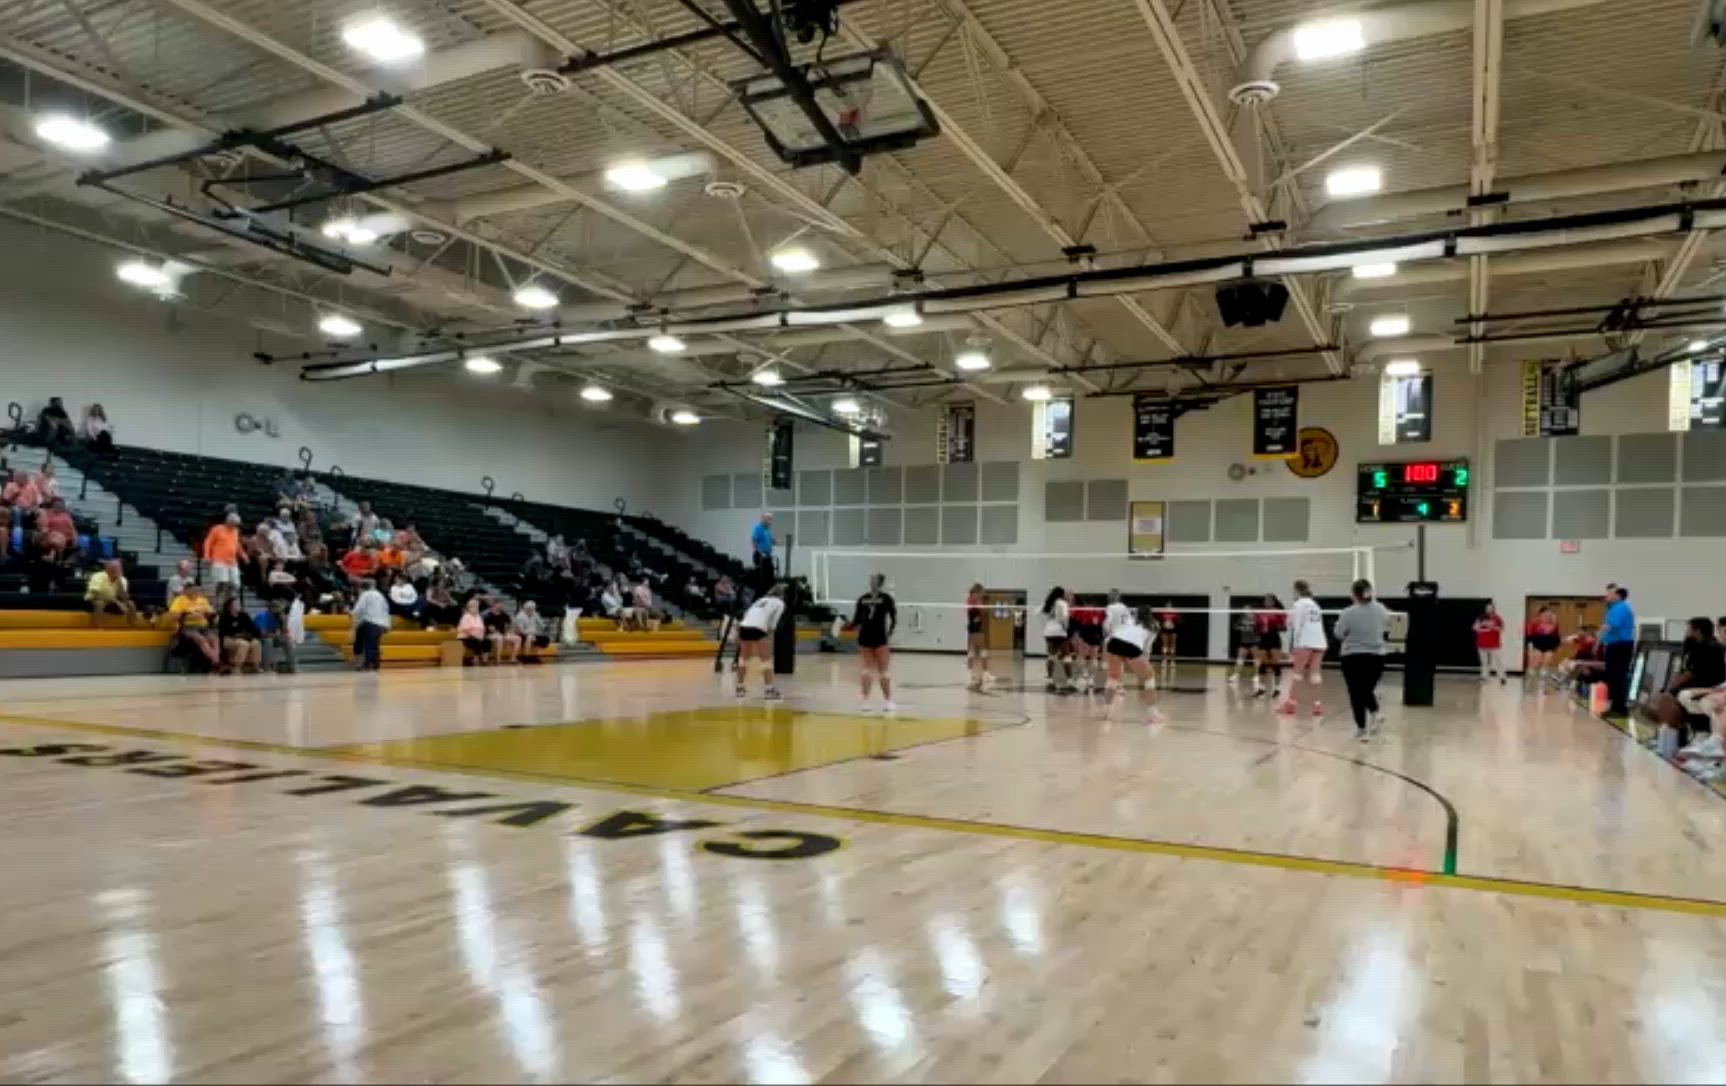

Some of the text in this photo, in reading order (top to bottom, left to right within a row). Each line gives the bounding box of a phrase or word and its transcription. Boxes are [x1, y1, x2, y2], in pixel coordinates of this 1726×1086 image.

[1455, 469, 1468, 486] 2
[1416, 502, 1429, 516] 4
[0, 743, 848, 859] CAVALIERS
